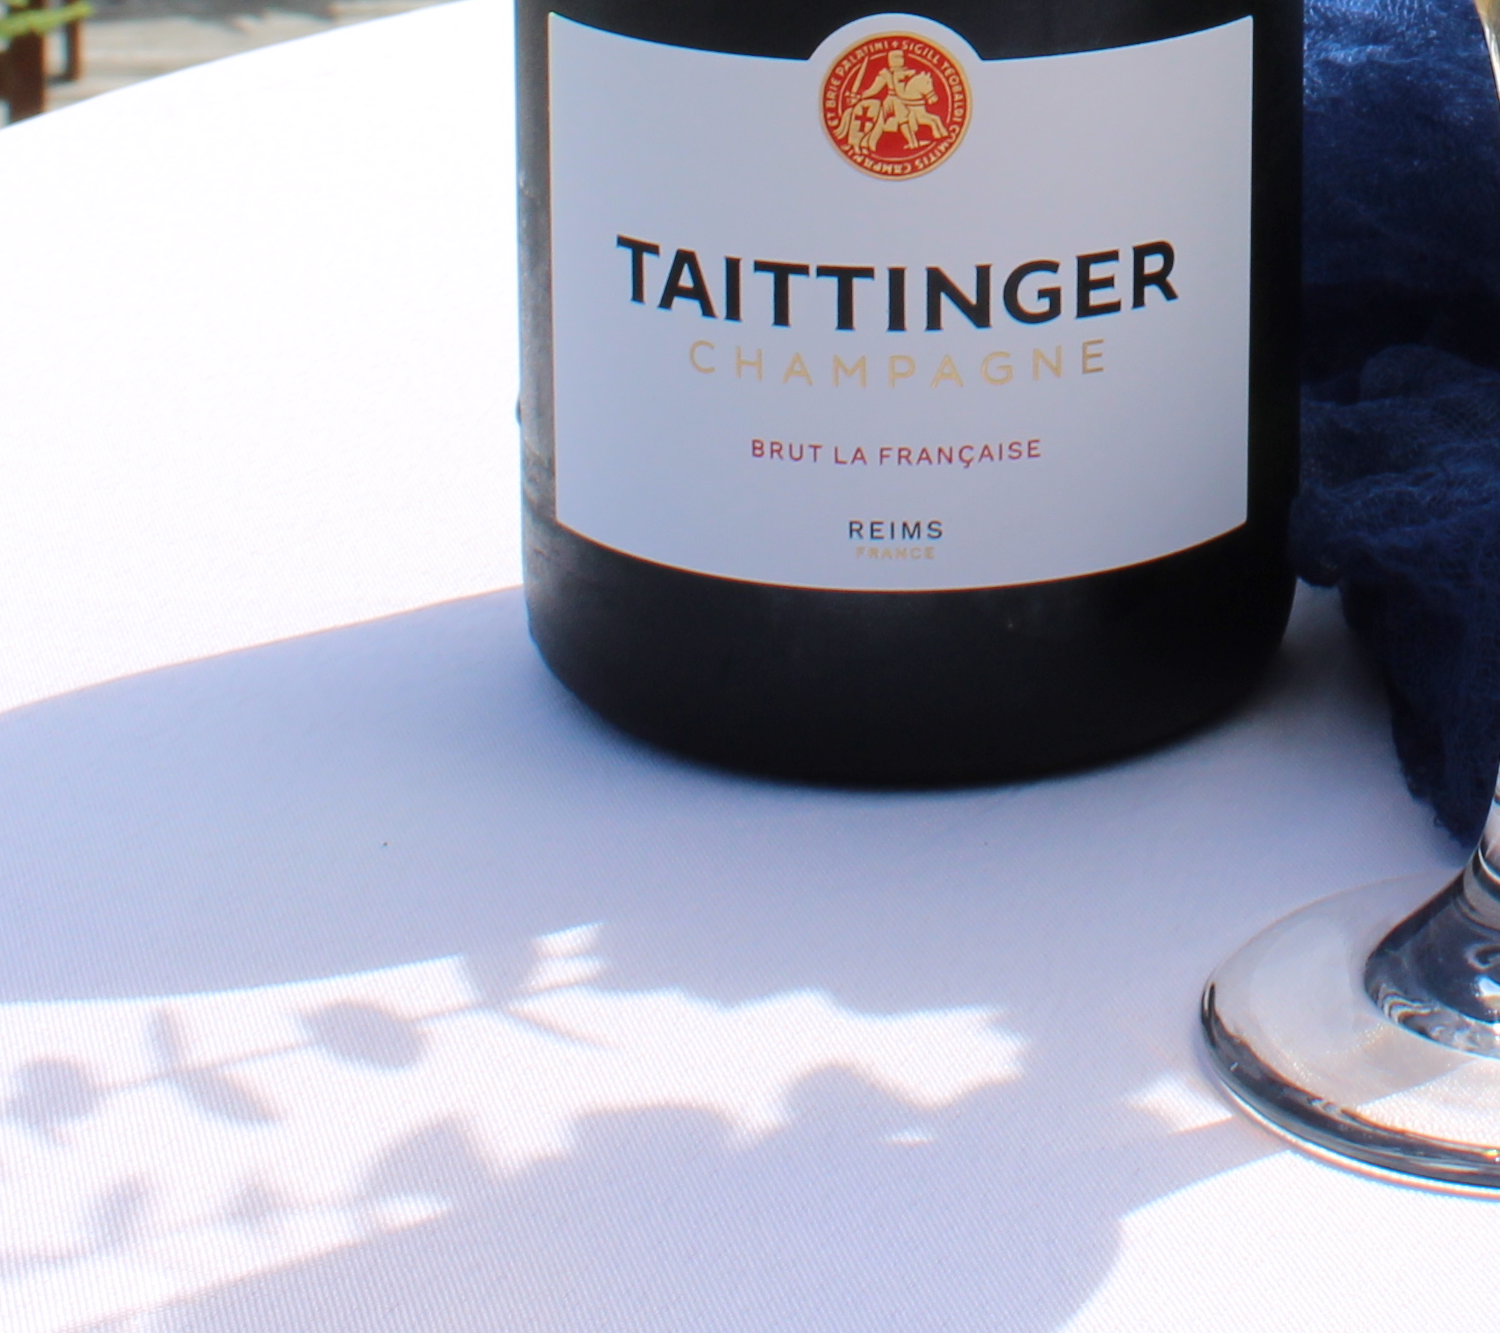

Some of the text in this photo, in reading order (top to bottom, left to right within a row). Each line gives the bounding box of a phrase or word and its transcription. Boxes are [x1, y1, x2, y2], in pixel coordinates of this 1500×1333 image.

[835, 40, 889, 77] PALATINI
[902, 40, 940, 65] SIGILL
[825, 77, 841, 109] BRIE
[941, 61, 964, 122] TEOBALDI
[616, 234, 1179, 332] TAITTINGER
[689, 339, 1105, 389] CHAMPAGNE
[751, 438, 1042, 469] BRUT LA FRANÇAISE
[848, 520, 944, 540] REIMS
[855, 546, 937, 561] FRANCE
